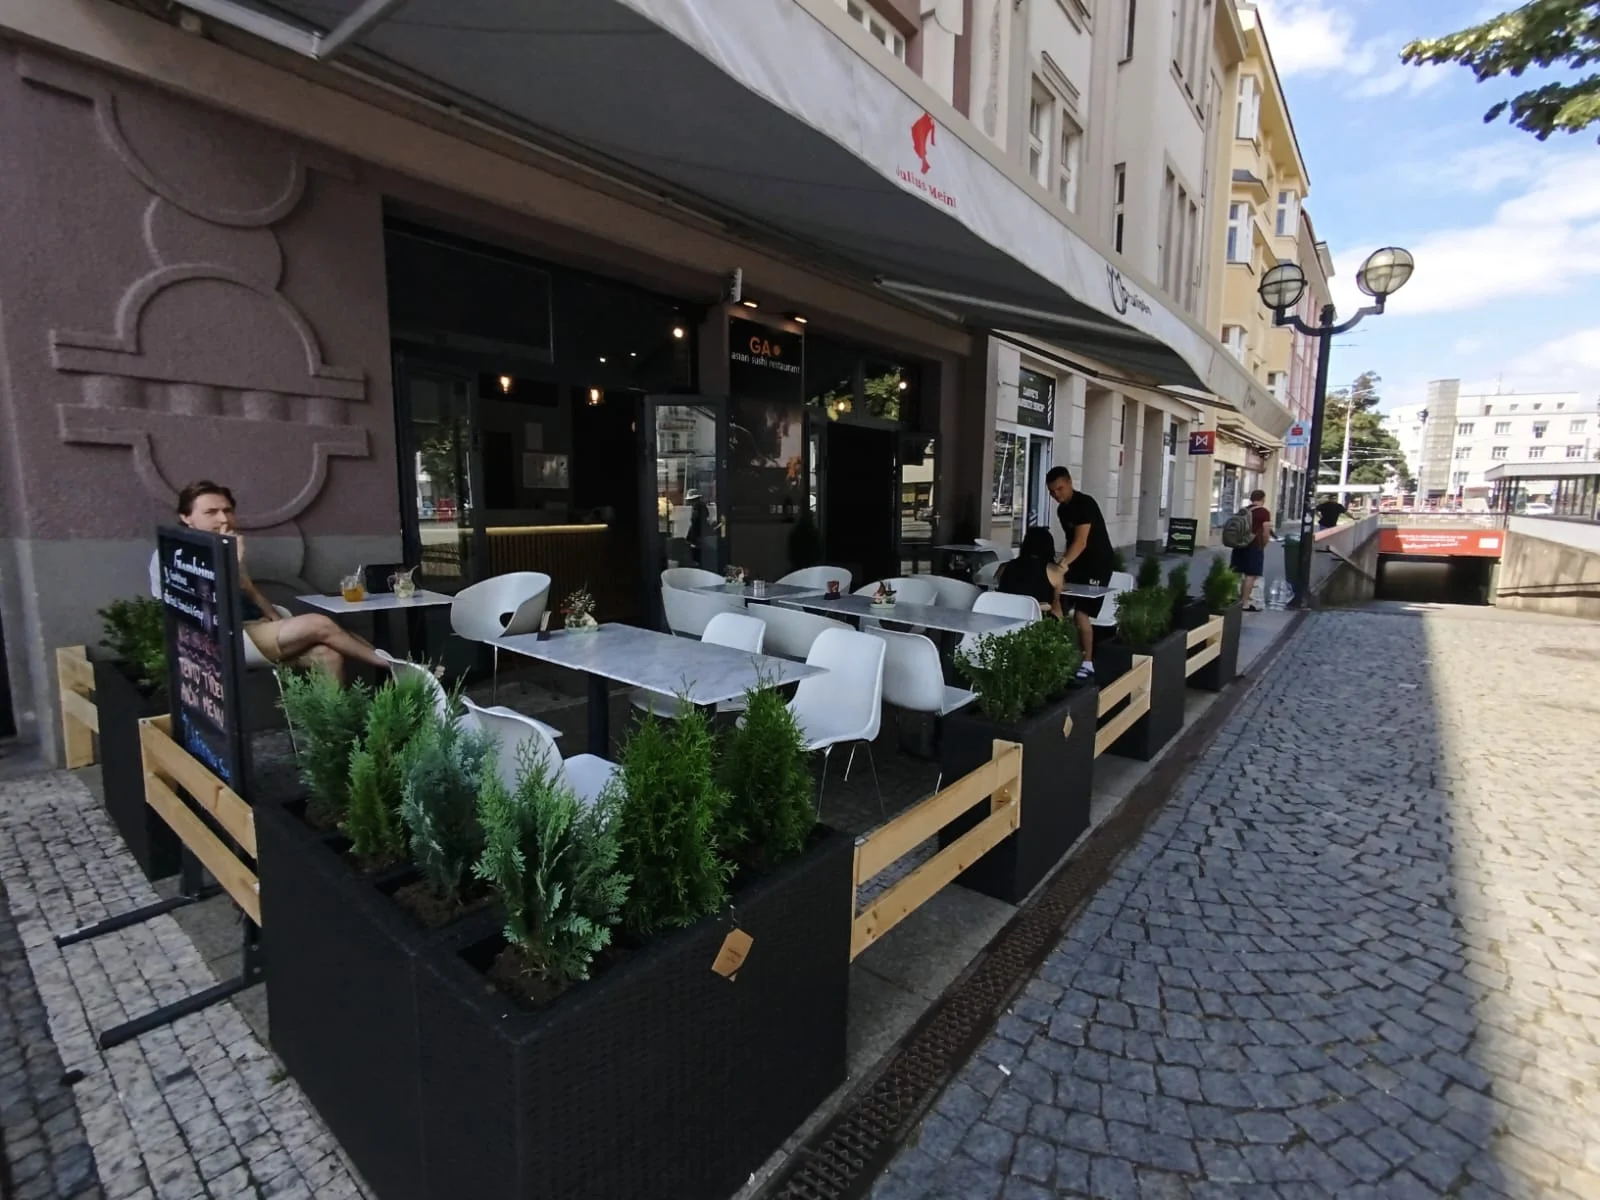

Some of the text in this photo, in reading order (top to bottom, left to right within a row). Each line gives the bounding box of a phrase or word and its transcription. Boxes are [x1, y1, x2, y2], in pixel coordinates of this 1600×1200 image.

[731, 352, 800, 375] asian sushi restaurant
